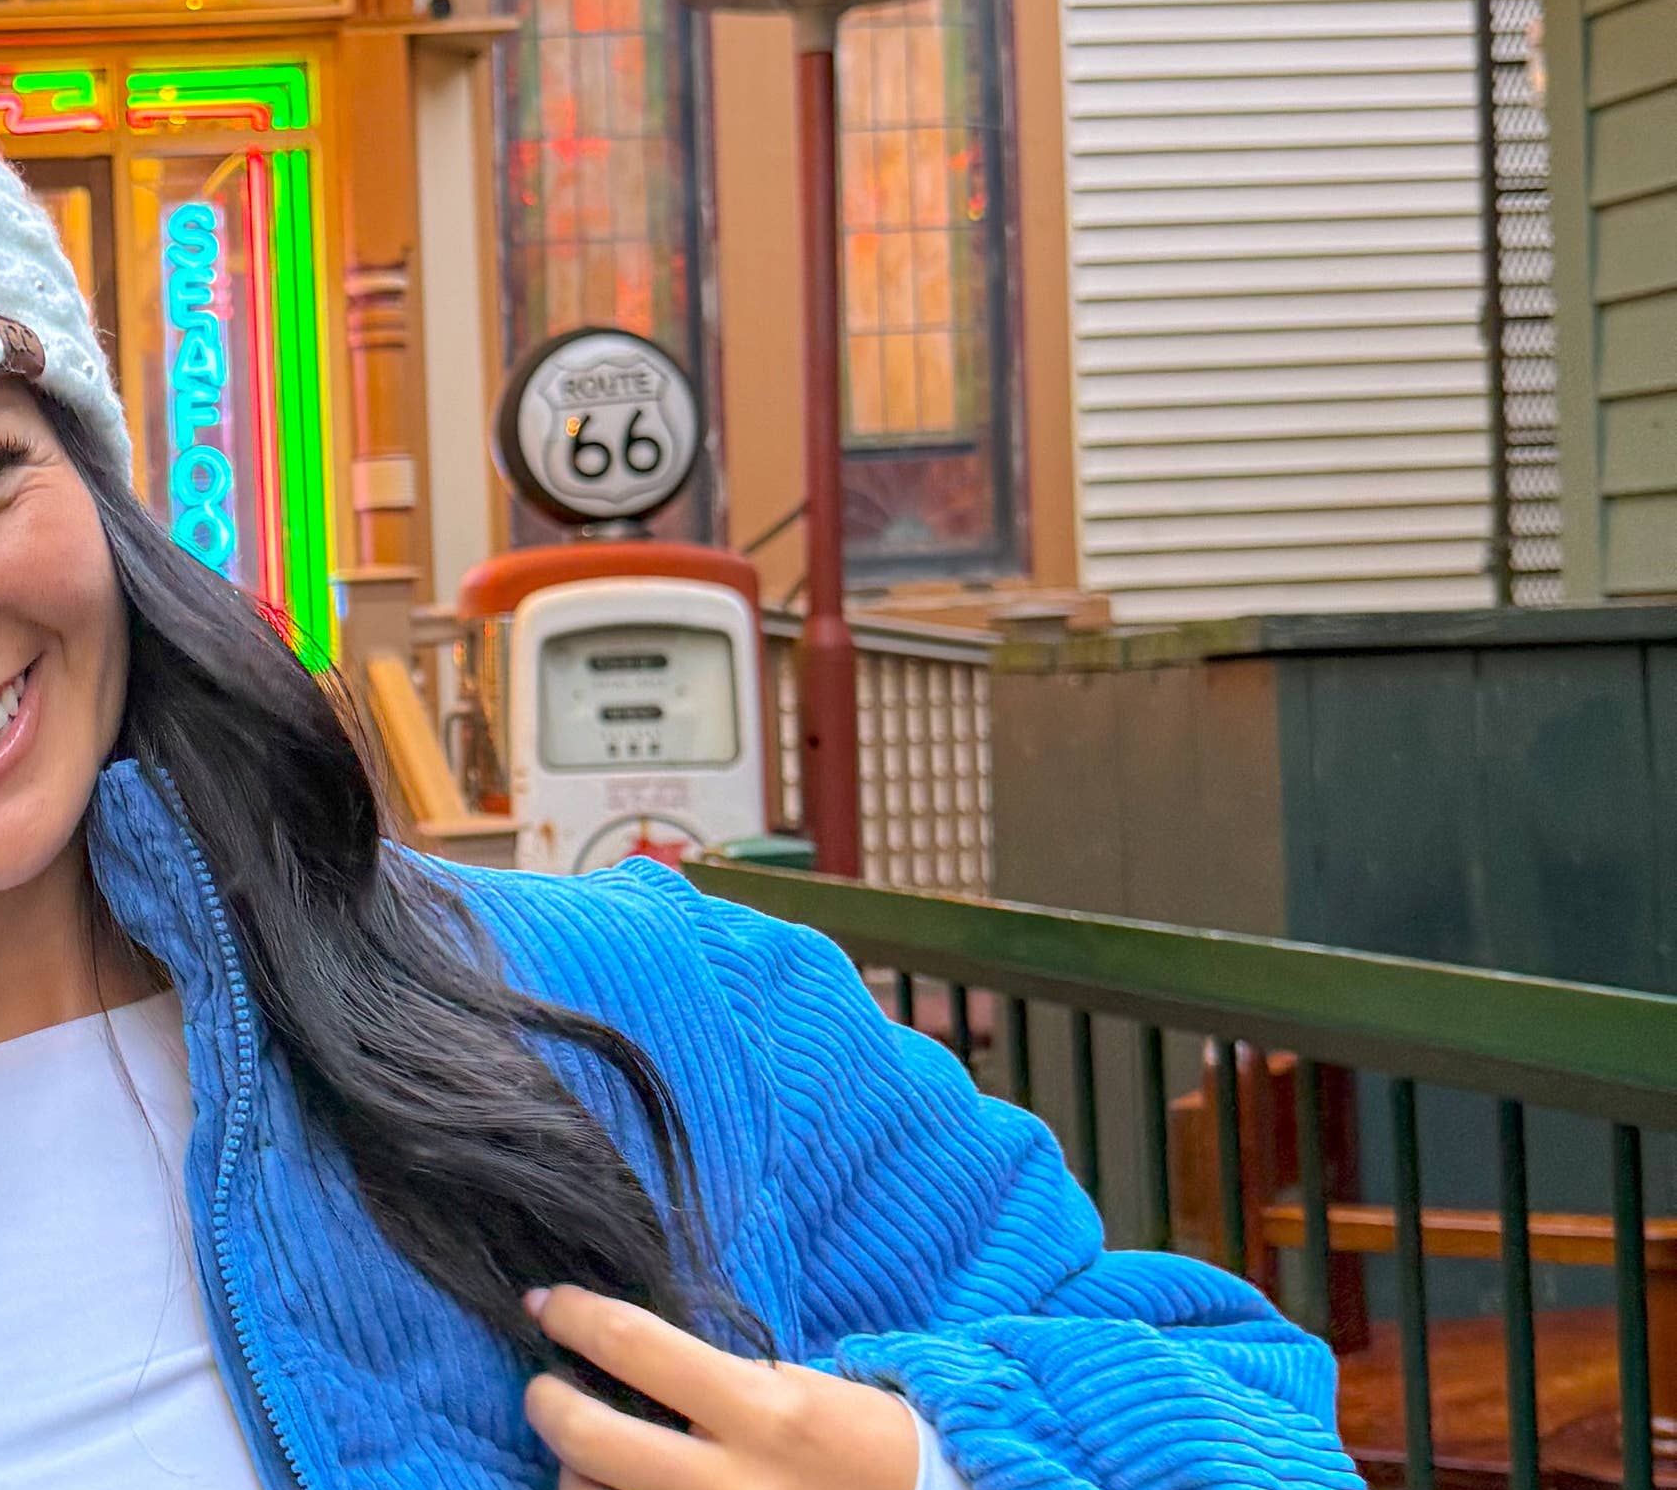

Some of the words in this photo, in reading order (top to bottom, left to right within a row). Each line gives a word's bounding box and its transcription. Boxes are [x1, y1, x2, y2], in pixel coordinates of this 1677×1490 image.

[165, 202, 234, 577] SEAFOO
[563, 372, 653, 401] ROUTE
[572, 409, 661, 478] 66
